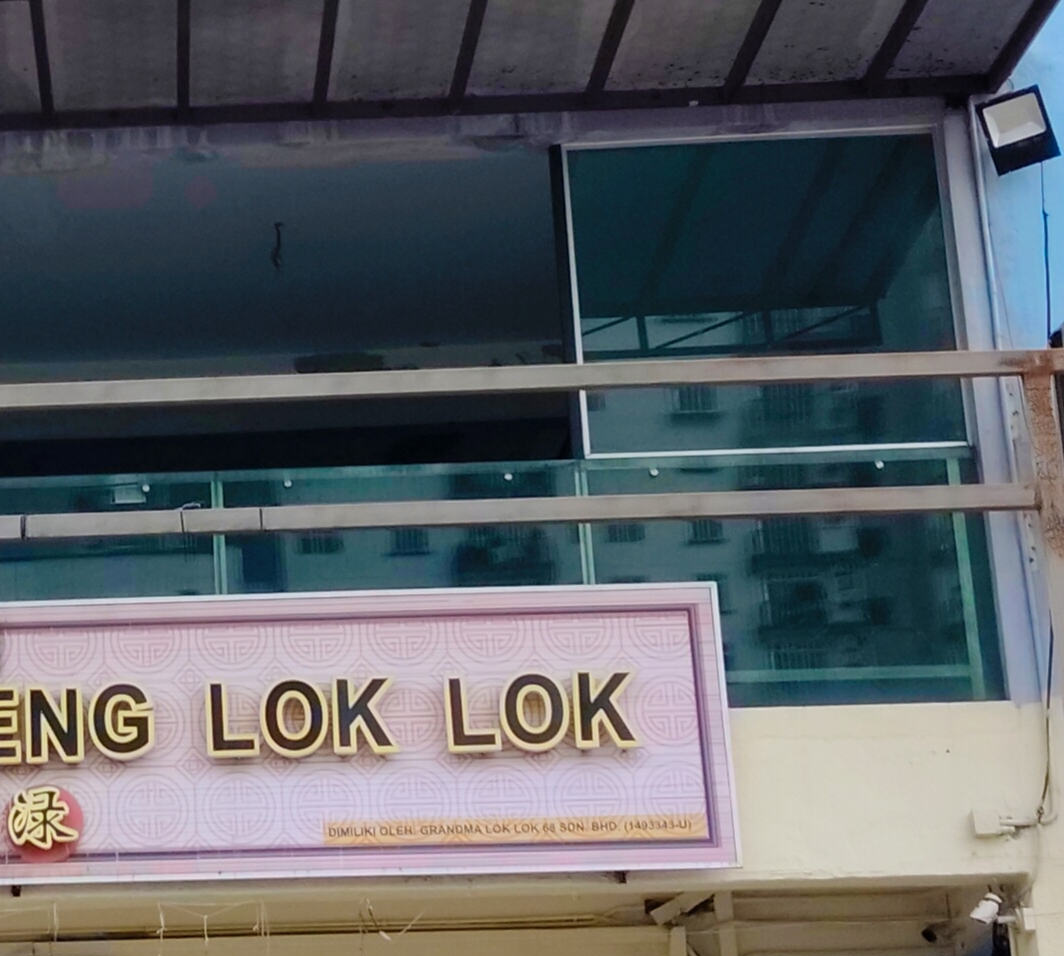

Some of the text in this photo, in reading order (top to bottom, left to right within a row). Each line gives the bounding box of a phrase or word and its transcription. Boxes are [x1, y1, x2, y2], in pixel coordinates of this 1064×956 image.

[205, 675, 400, 758] LOK
[443, 669, 643, 754] LOK
[327, 826, 376, 838] DIMILIKI
[420, 823, 483, 836] GRANDMA
[485, 823, 511, 834] LOK
[514, 822, 539, 834] LOK
[542, 822, 556, 833] 68
